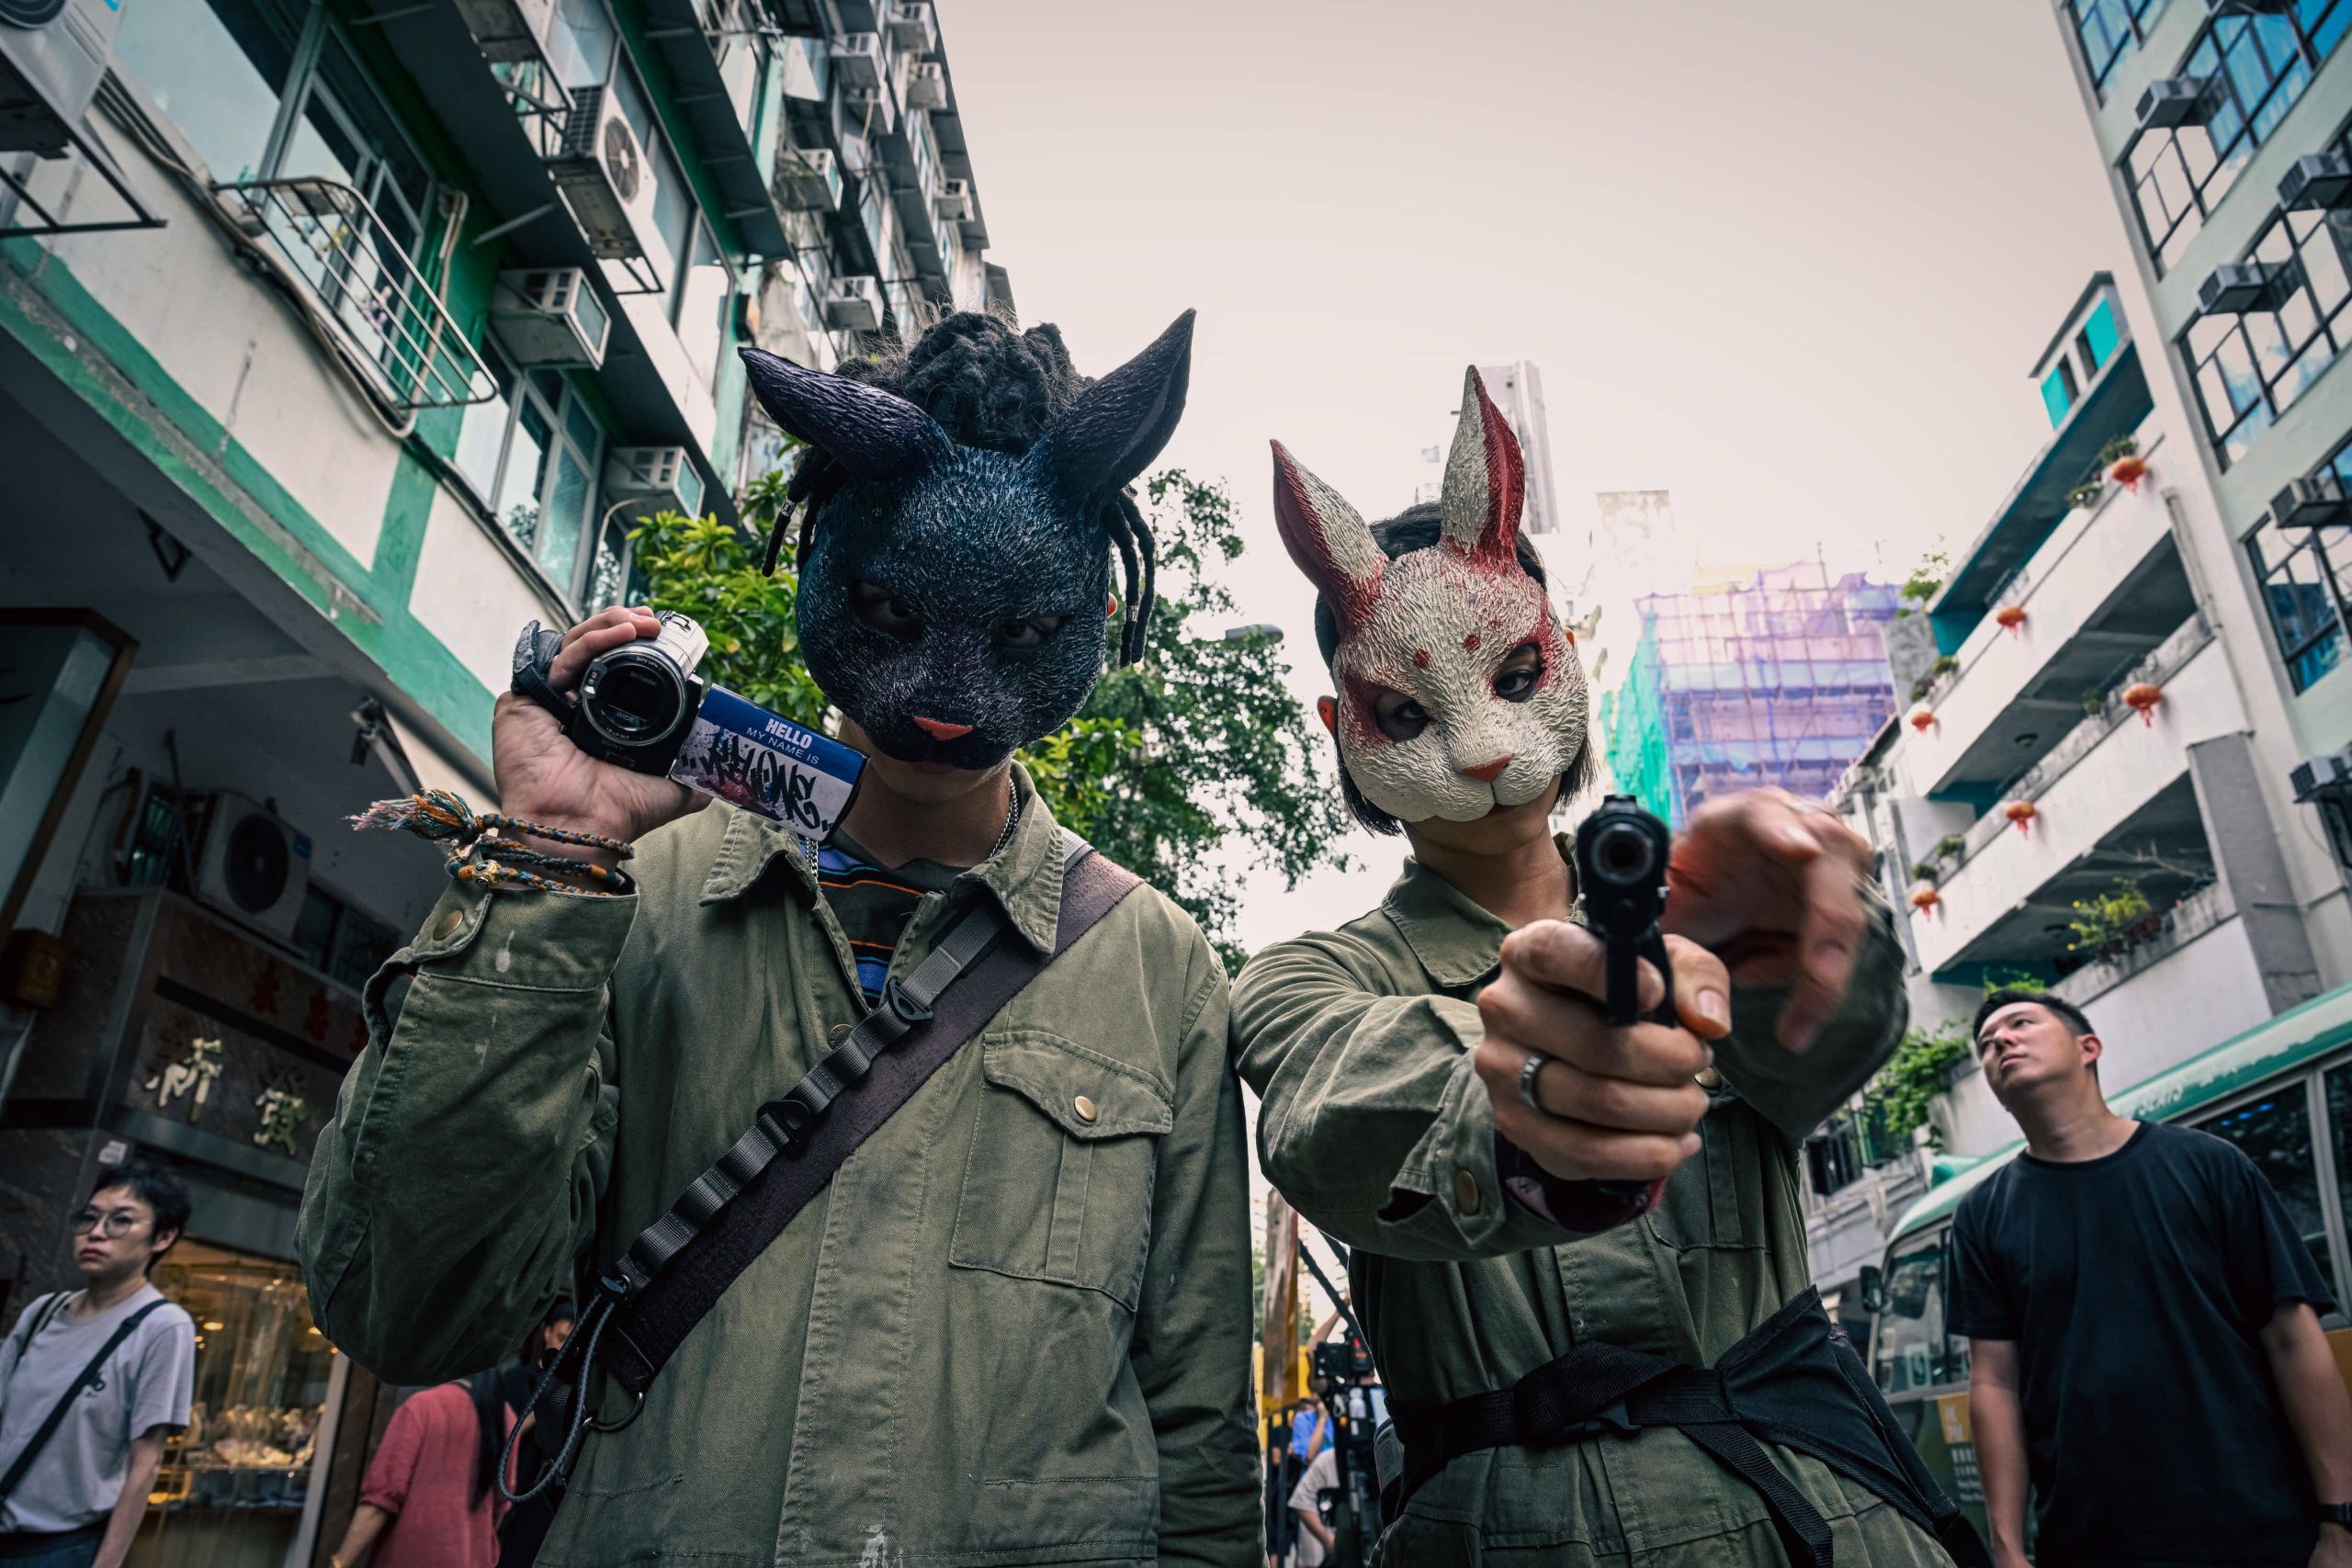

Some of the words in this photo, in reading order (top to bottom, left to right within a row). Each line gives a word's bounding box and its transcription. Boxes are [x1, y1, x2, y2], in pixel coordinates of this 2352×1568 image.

[616, 711, 633, 723] WIDE
[746, 727, 763, 740] MY
[768, 737, 805, 758] NAME
[807, 753, 820, 765] IS
[764, 718, 813, 749] HELLO
